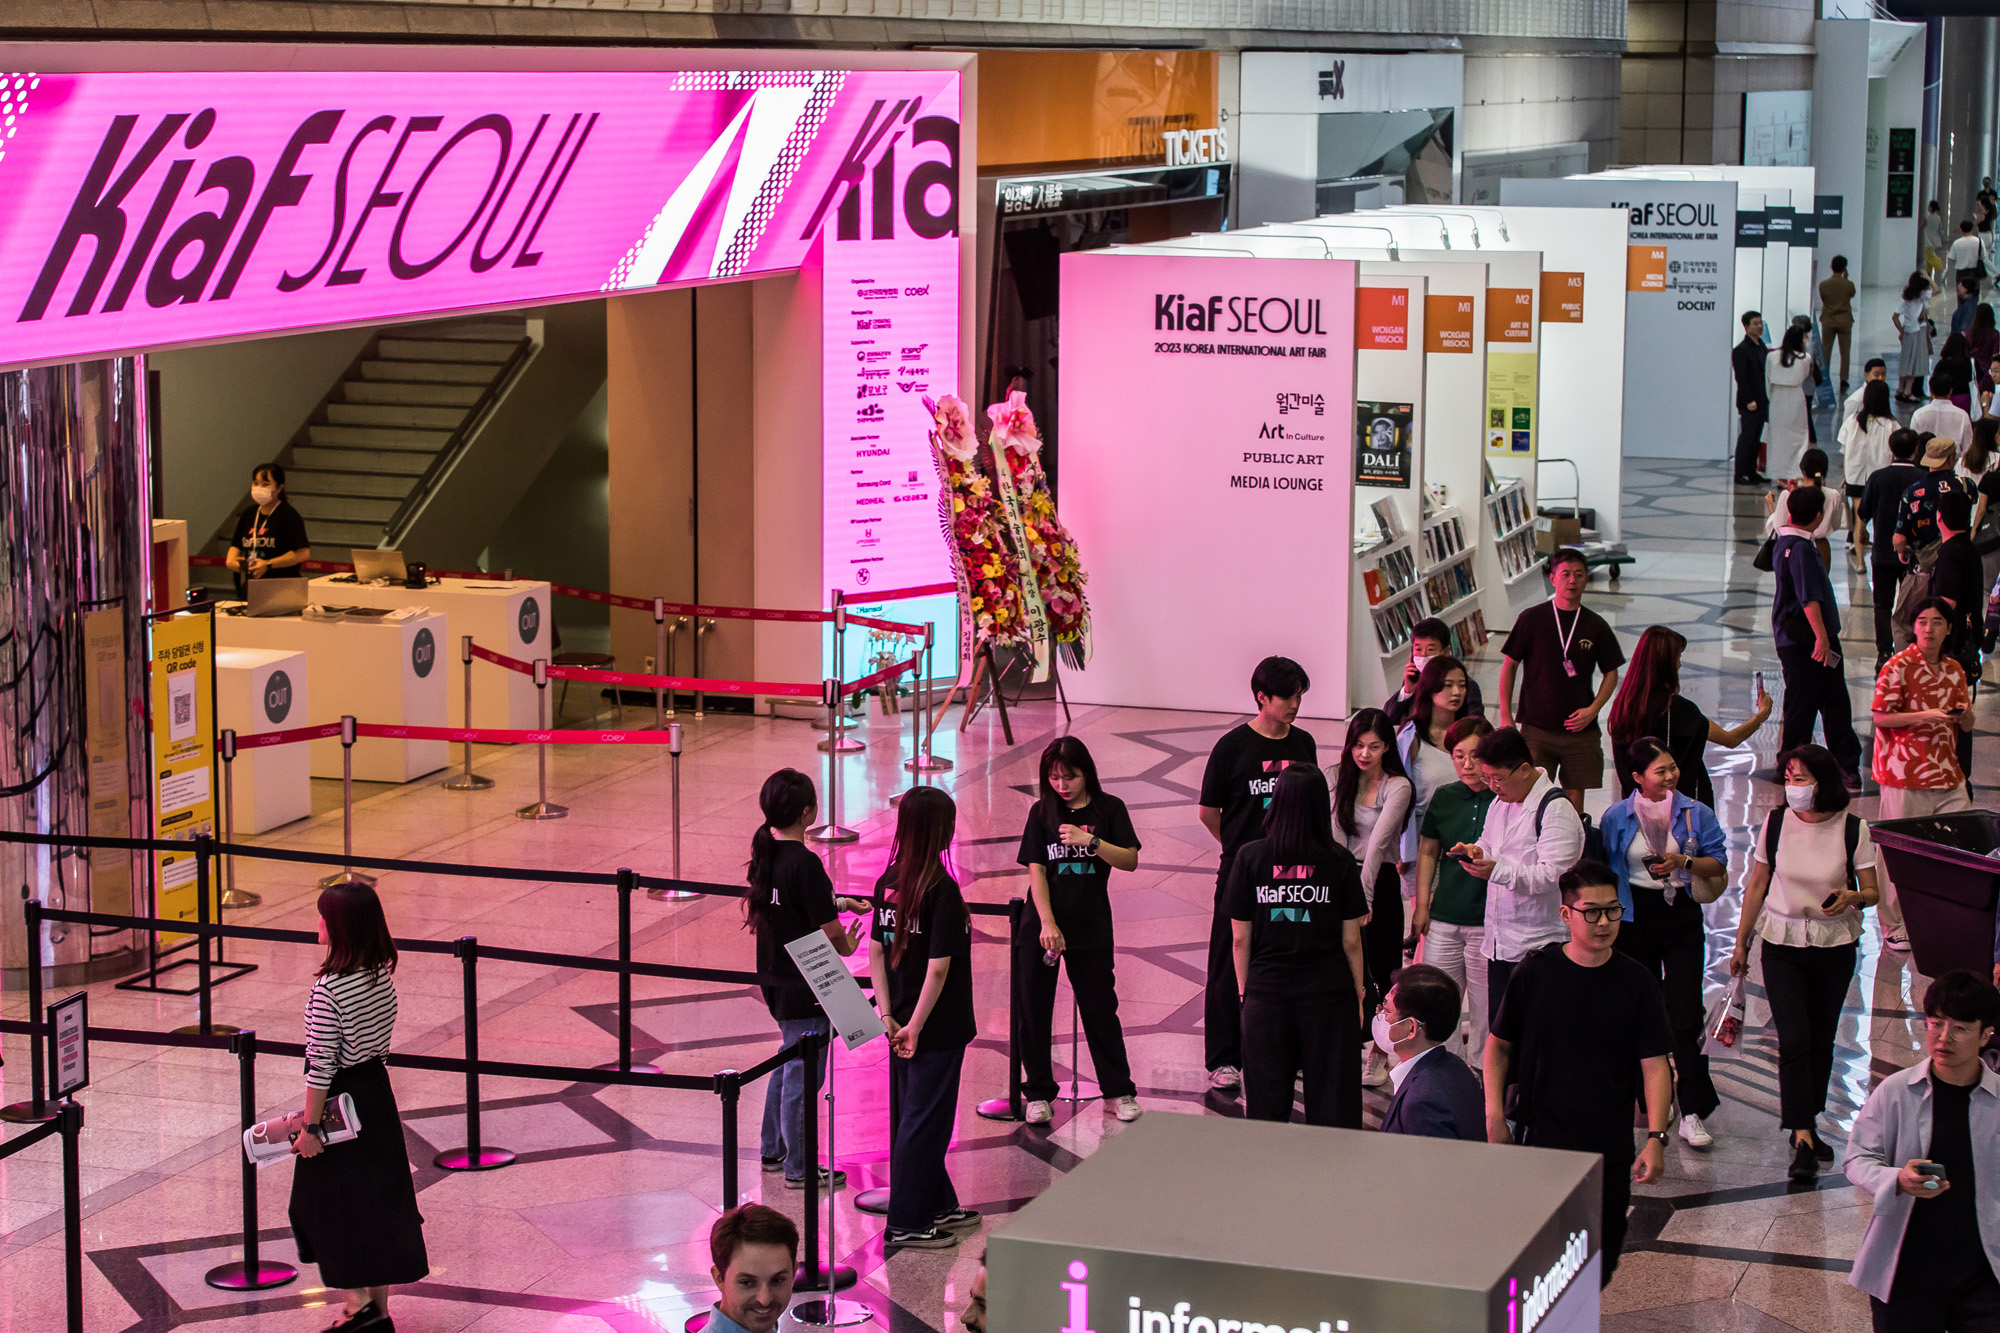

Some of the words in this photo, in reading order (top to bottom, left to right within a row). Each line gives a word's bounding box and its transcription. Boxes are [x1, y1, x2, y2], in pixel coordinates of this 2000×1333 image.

[1161, 127, 1229, 166] TICKETS
[17, 107, 346, 323] Kiaf
[275, 113, 601, 293] SEOUL
[1656, 203, 1719, 227] SEOUL
[1651, 250, 1665, 260] M4
[1568, 277, 1582, 288] M3
[904, 284, 930, 296] coex
[1391, 295, 1405, 306] M1
[1515, 294, 1530, 305] M2
[1458, 302, 1471, 312] M1
[1677, 301, 1716, 311] DOCENT
[1155, 293, 1223, 332] Kiaf
[1227, 296, 1327, 335] SEOUL
[856, 319, 872, 330] Kiaf
[1371, 326, 1405, 334] WOLGAN
[1510, 321, 1521, 329] ART
[1522, 321, 1529, 329] IN
[1375, 335, 1404, 343] MISOOL
[1440, 331, 1471, 339] WOLGAN
[1504, 329, 1530, 337] CULTURE
[1442, 339, 1470, 347] MISOOL
[1154, 342, 1182, 353] 2023
[1183, 343, 1215, 354] KOREA
[1217, 344, 1287, 357] INTERNATIONAL
[1289, 346, 1306, 357] ART
[1307, 347, 1327, 358] FAIR
[1276, 393, 1325, 416] 월간미술
[1258, 421, 1285, 439] Art
[1294, 433, 1325, 441] Culture
[856, 448, 890, 458] HYUNDAI
[1242, 452, 1295, 464] PUBLIC
[1296, 454, 1325, 465] ART
[1230, 475, 1270, 489] MEDIA
[1273, 476, 1325, 491] LOUNGE
[521, 611, 538, 631] OUT
[415, 645, 434, 665] OUT
[166, 661, 178, 674] QR
[179, 657, 197, 671] code
[546, 668, 567, 677] coex
[268, 685, 290, 709] OUT
[383, 726, 408, 738] coex
[453, 729, 480, 740] coex
[526, 731, 553, 742] coex
[601, 731, 627, 742] coex
[260, 732, 283, 745] coex
[1248, 778, 1276, 795] Kiaf
[1046, 842, 1070, 860] Kiaf
[1256, 885, 1287, 904] Kiaf
[1286, 885, 1331, 903] SEOUL
[1521, 1229, 1589, 1333] information
